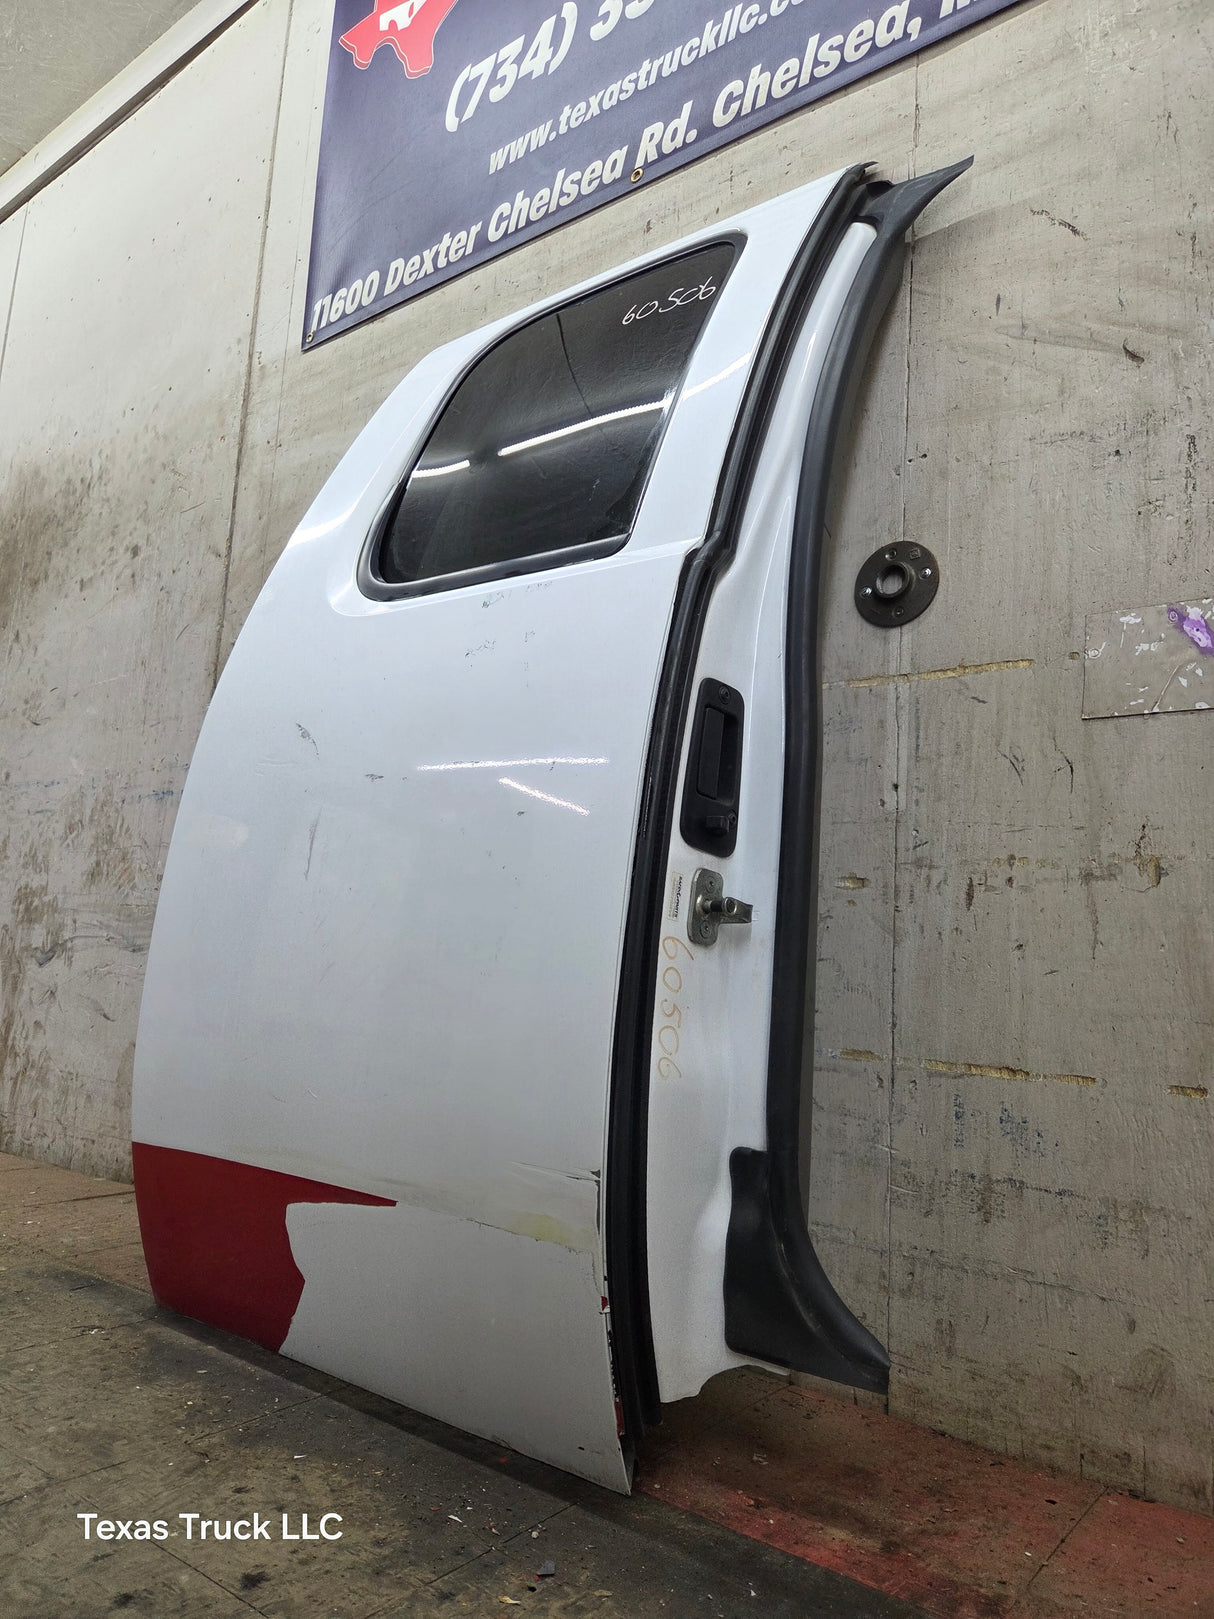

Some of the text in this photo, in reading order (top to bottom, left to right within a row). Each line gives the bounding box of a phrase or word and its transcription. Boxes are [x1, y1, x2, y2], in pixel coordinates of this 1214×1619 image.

[445, 2, 578, 132] (734)
[488, 0, 804, 175] www.texastruckllc.c
[310, 0, 922, 333] 11600 Dexter Chelsea Rd. Chelsea,
